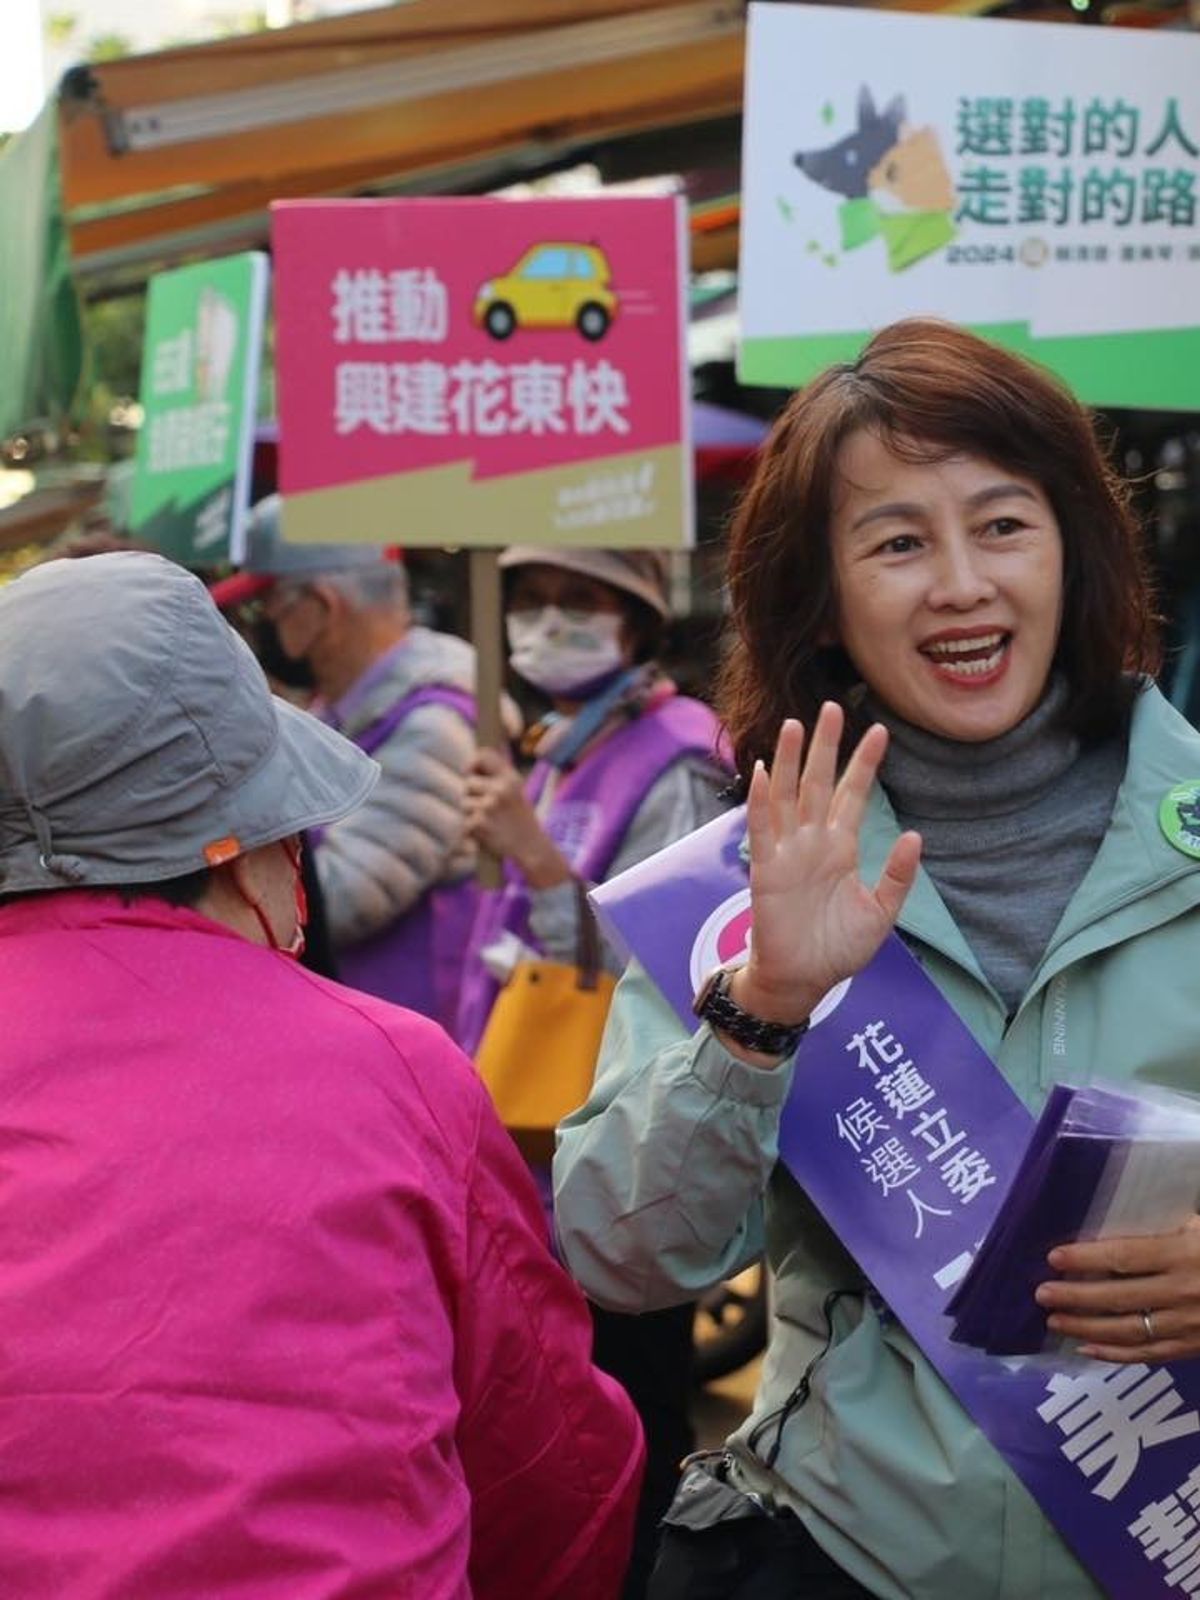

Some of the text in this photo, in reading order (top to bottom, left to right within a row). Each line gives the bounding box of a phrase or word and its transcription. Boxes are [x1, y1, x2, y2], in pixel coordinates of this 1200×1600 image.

[955, 95, 1200, 159] 選對的人
[946, 243, 1015, 265] 2024
[330, 267, 449, 344] 推動
[334, 359, 630, 437] 興建花東快
[845, 1019, 997, 1205] 花蓮立委
[834, 1096, 952, 1240] 候選人
